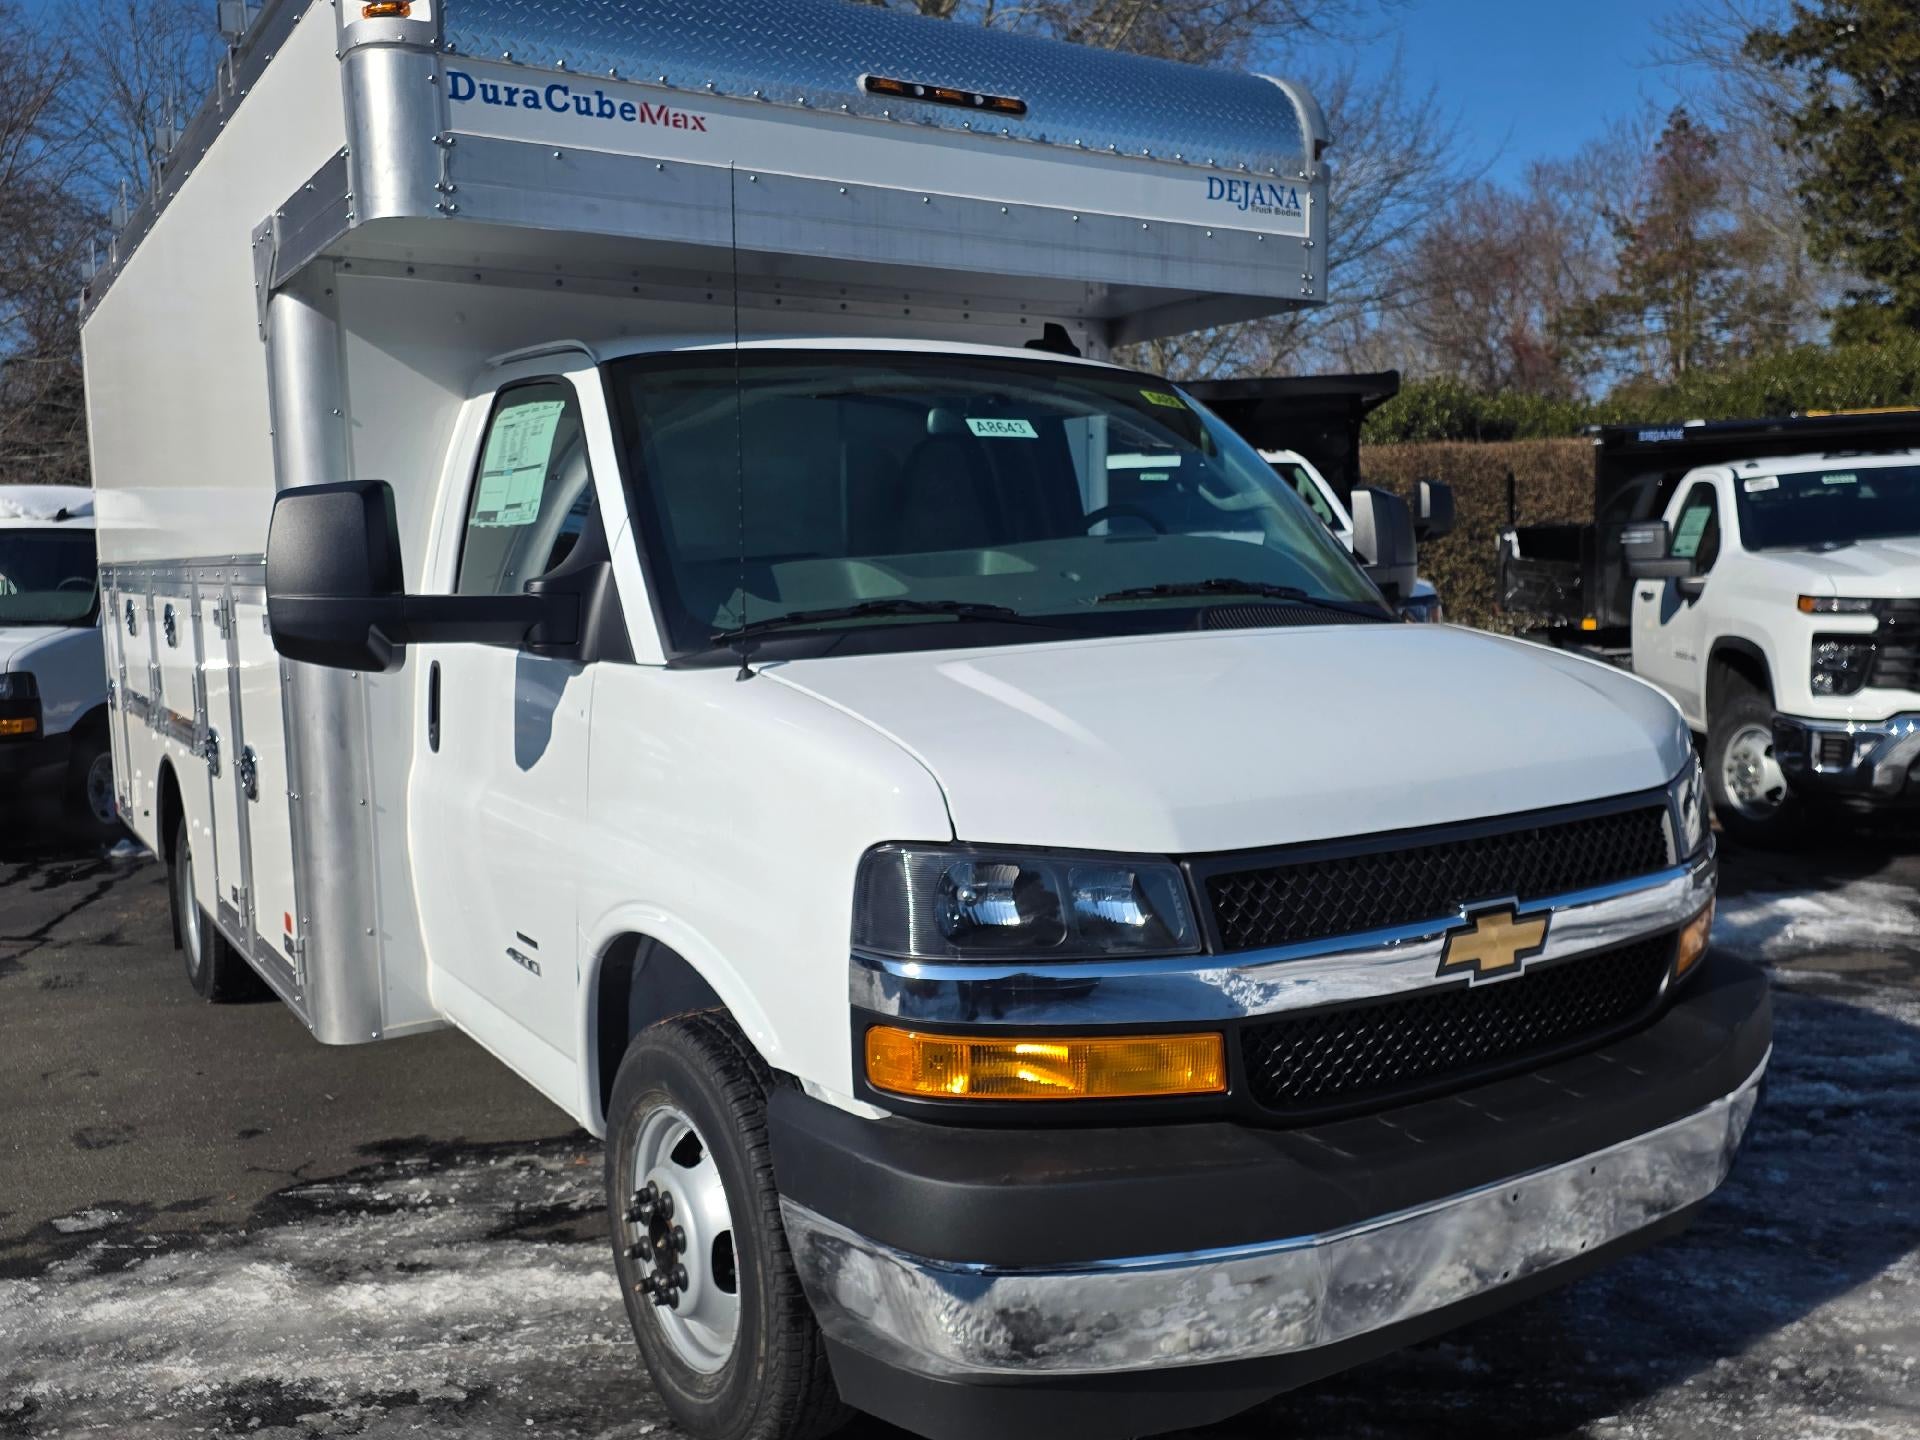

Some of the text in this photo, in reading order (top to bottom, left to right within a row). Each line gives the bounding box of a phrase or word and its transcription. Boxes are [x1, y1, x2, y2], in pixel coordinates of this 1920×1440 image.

[446, 71, 707, 132] DuraCubeMax
[1207, 176, 1301, 211] DEJANA
[976, 421, 1027, 433] A8643
